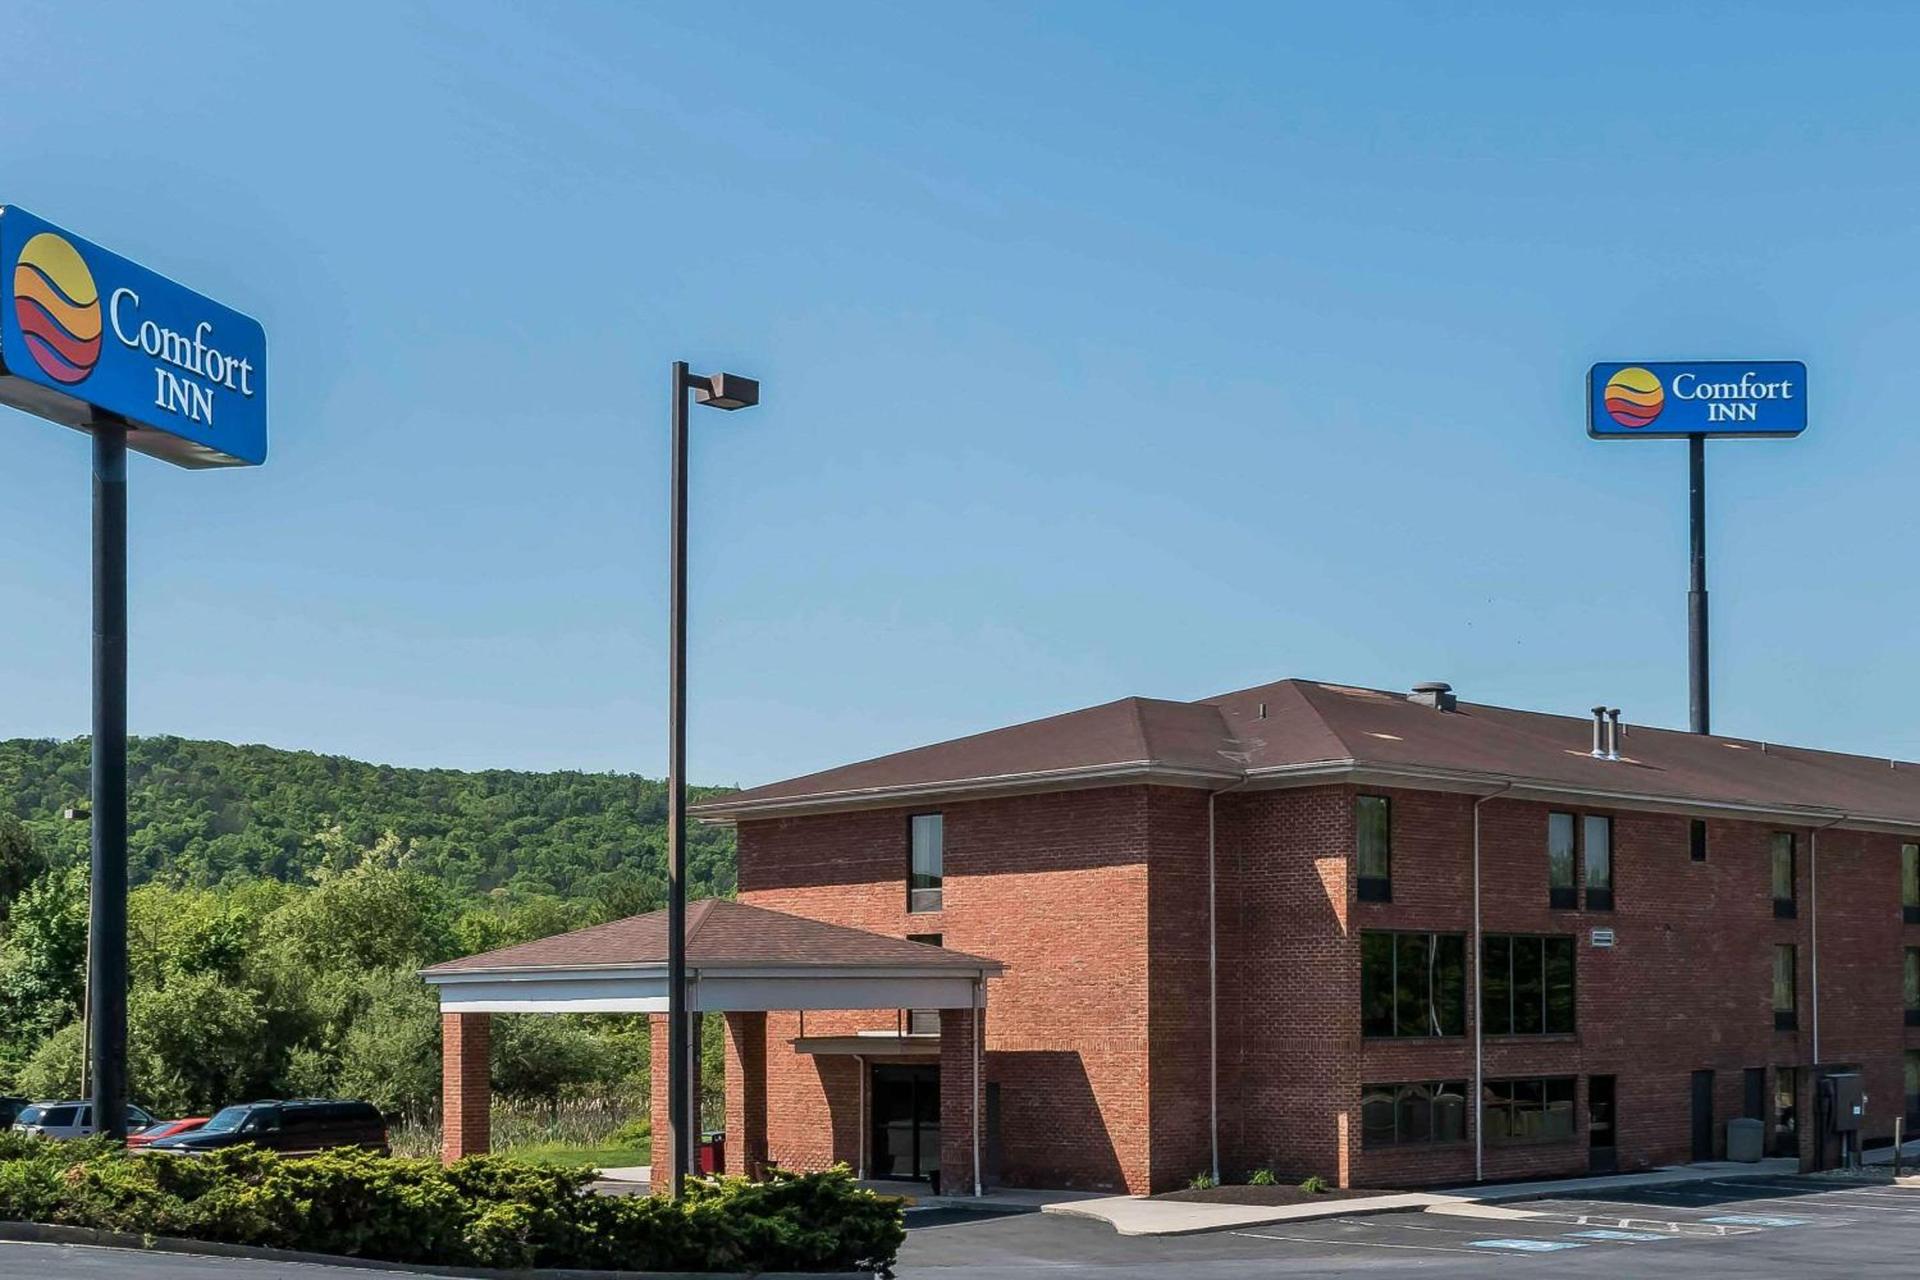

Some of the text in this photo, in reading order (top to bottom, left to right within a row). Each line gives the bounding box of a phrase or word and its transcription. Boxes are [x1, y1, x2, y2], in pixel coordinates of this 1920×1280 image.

[110, 287, 253, 396] Comfort
[154, 367, 214, 425] INN
[1672, 372, 1793, 400] Comfort
[1707, 403, 1757, 421] INN
